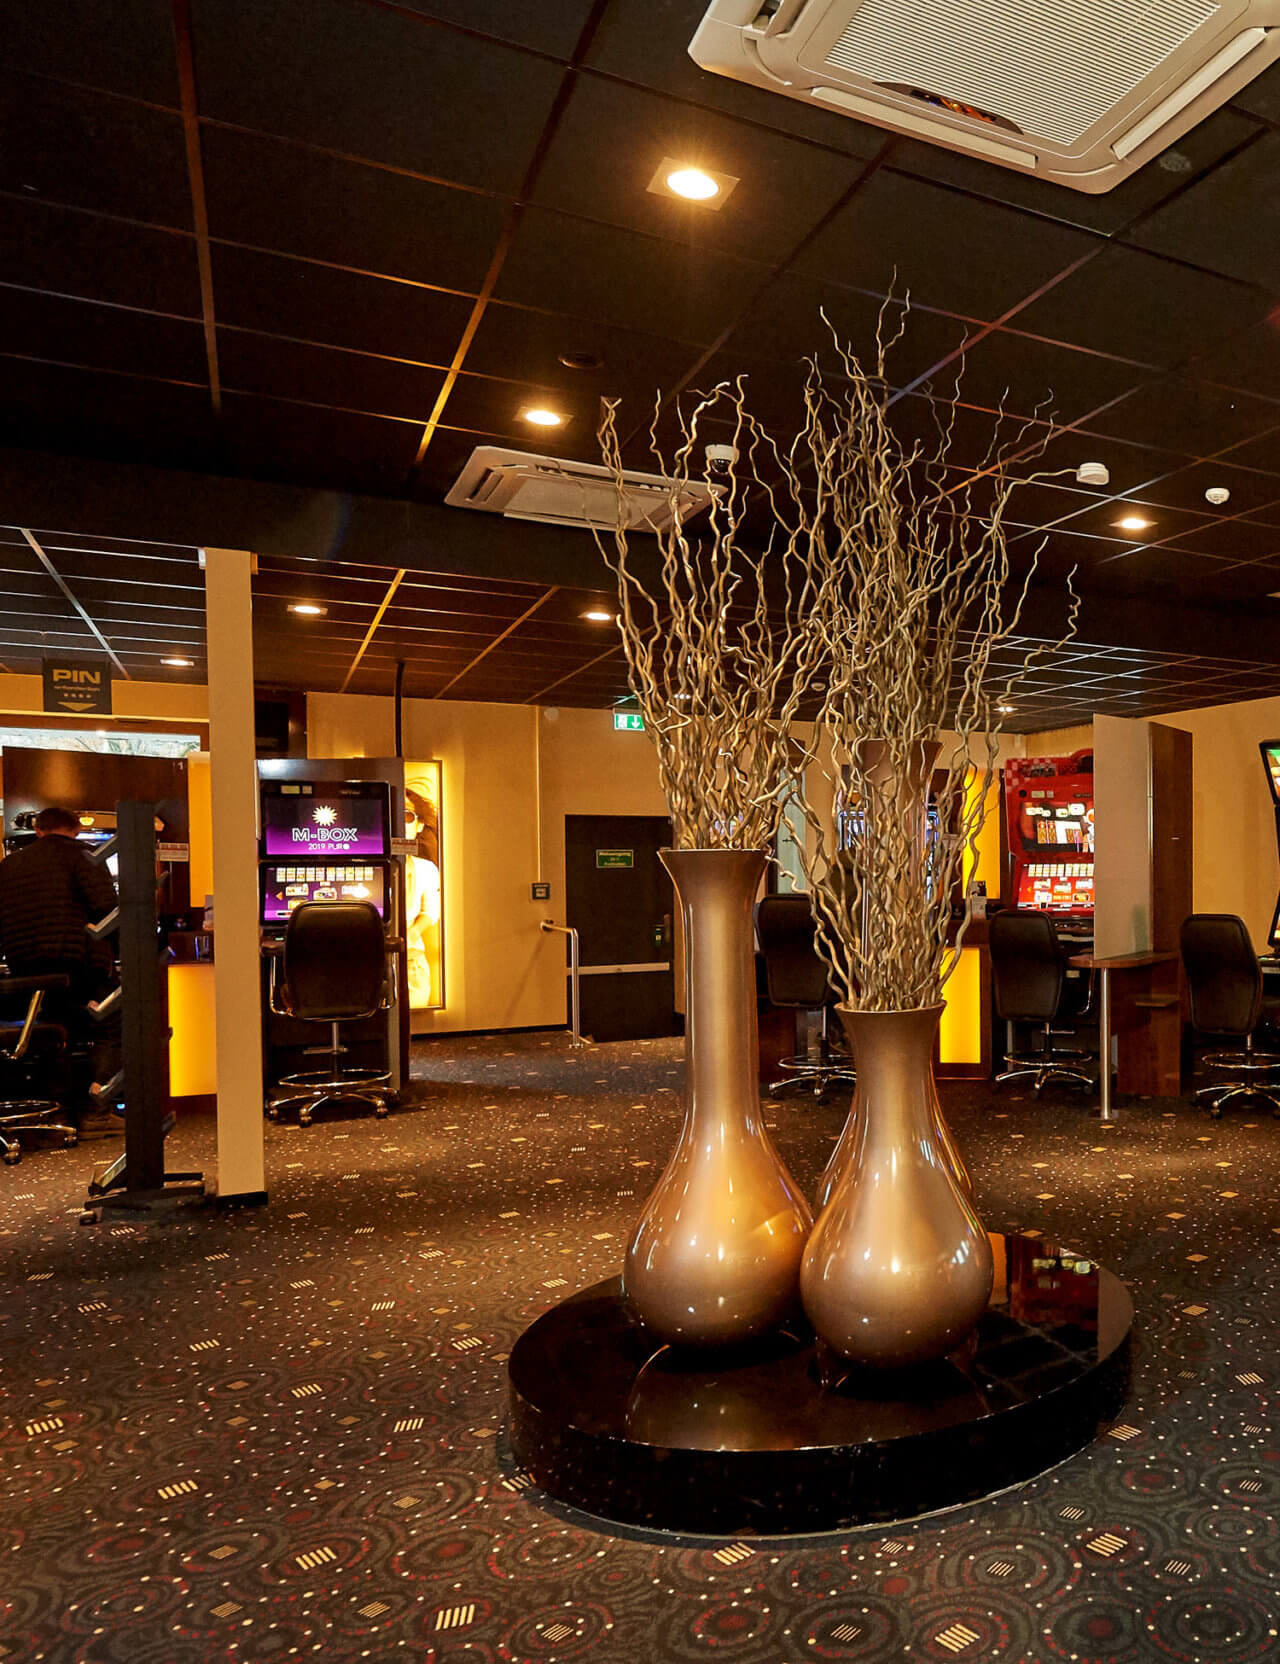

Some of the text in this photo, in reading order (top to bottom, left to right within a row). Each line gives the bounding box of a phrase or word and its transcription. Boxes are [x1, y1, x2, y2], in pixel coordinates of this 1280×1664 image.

[52, 668, 101, 685] PIN
[291, 827, 360, 843] M-BOX
[308, 843, 326, 851] 2019
